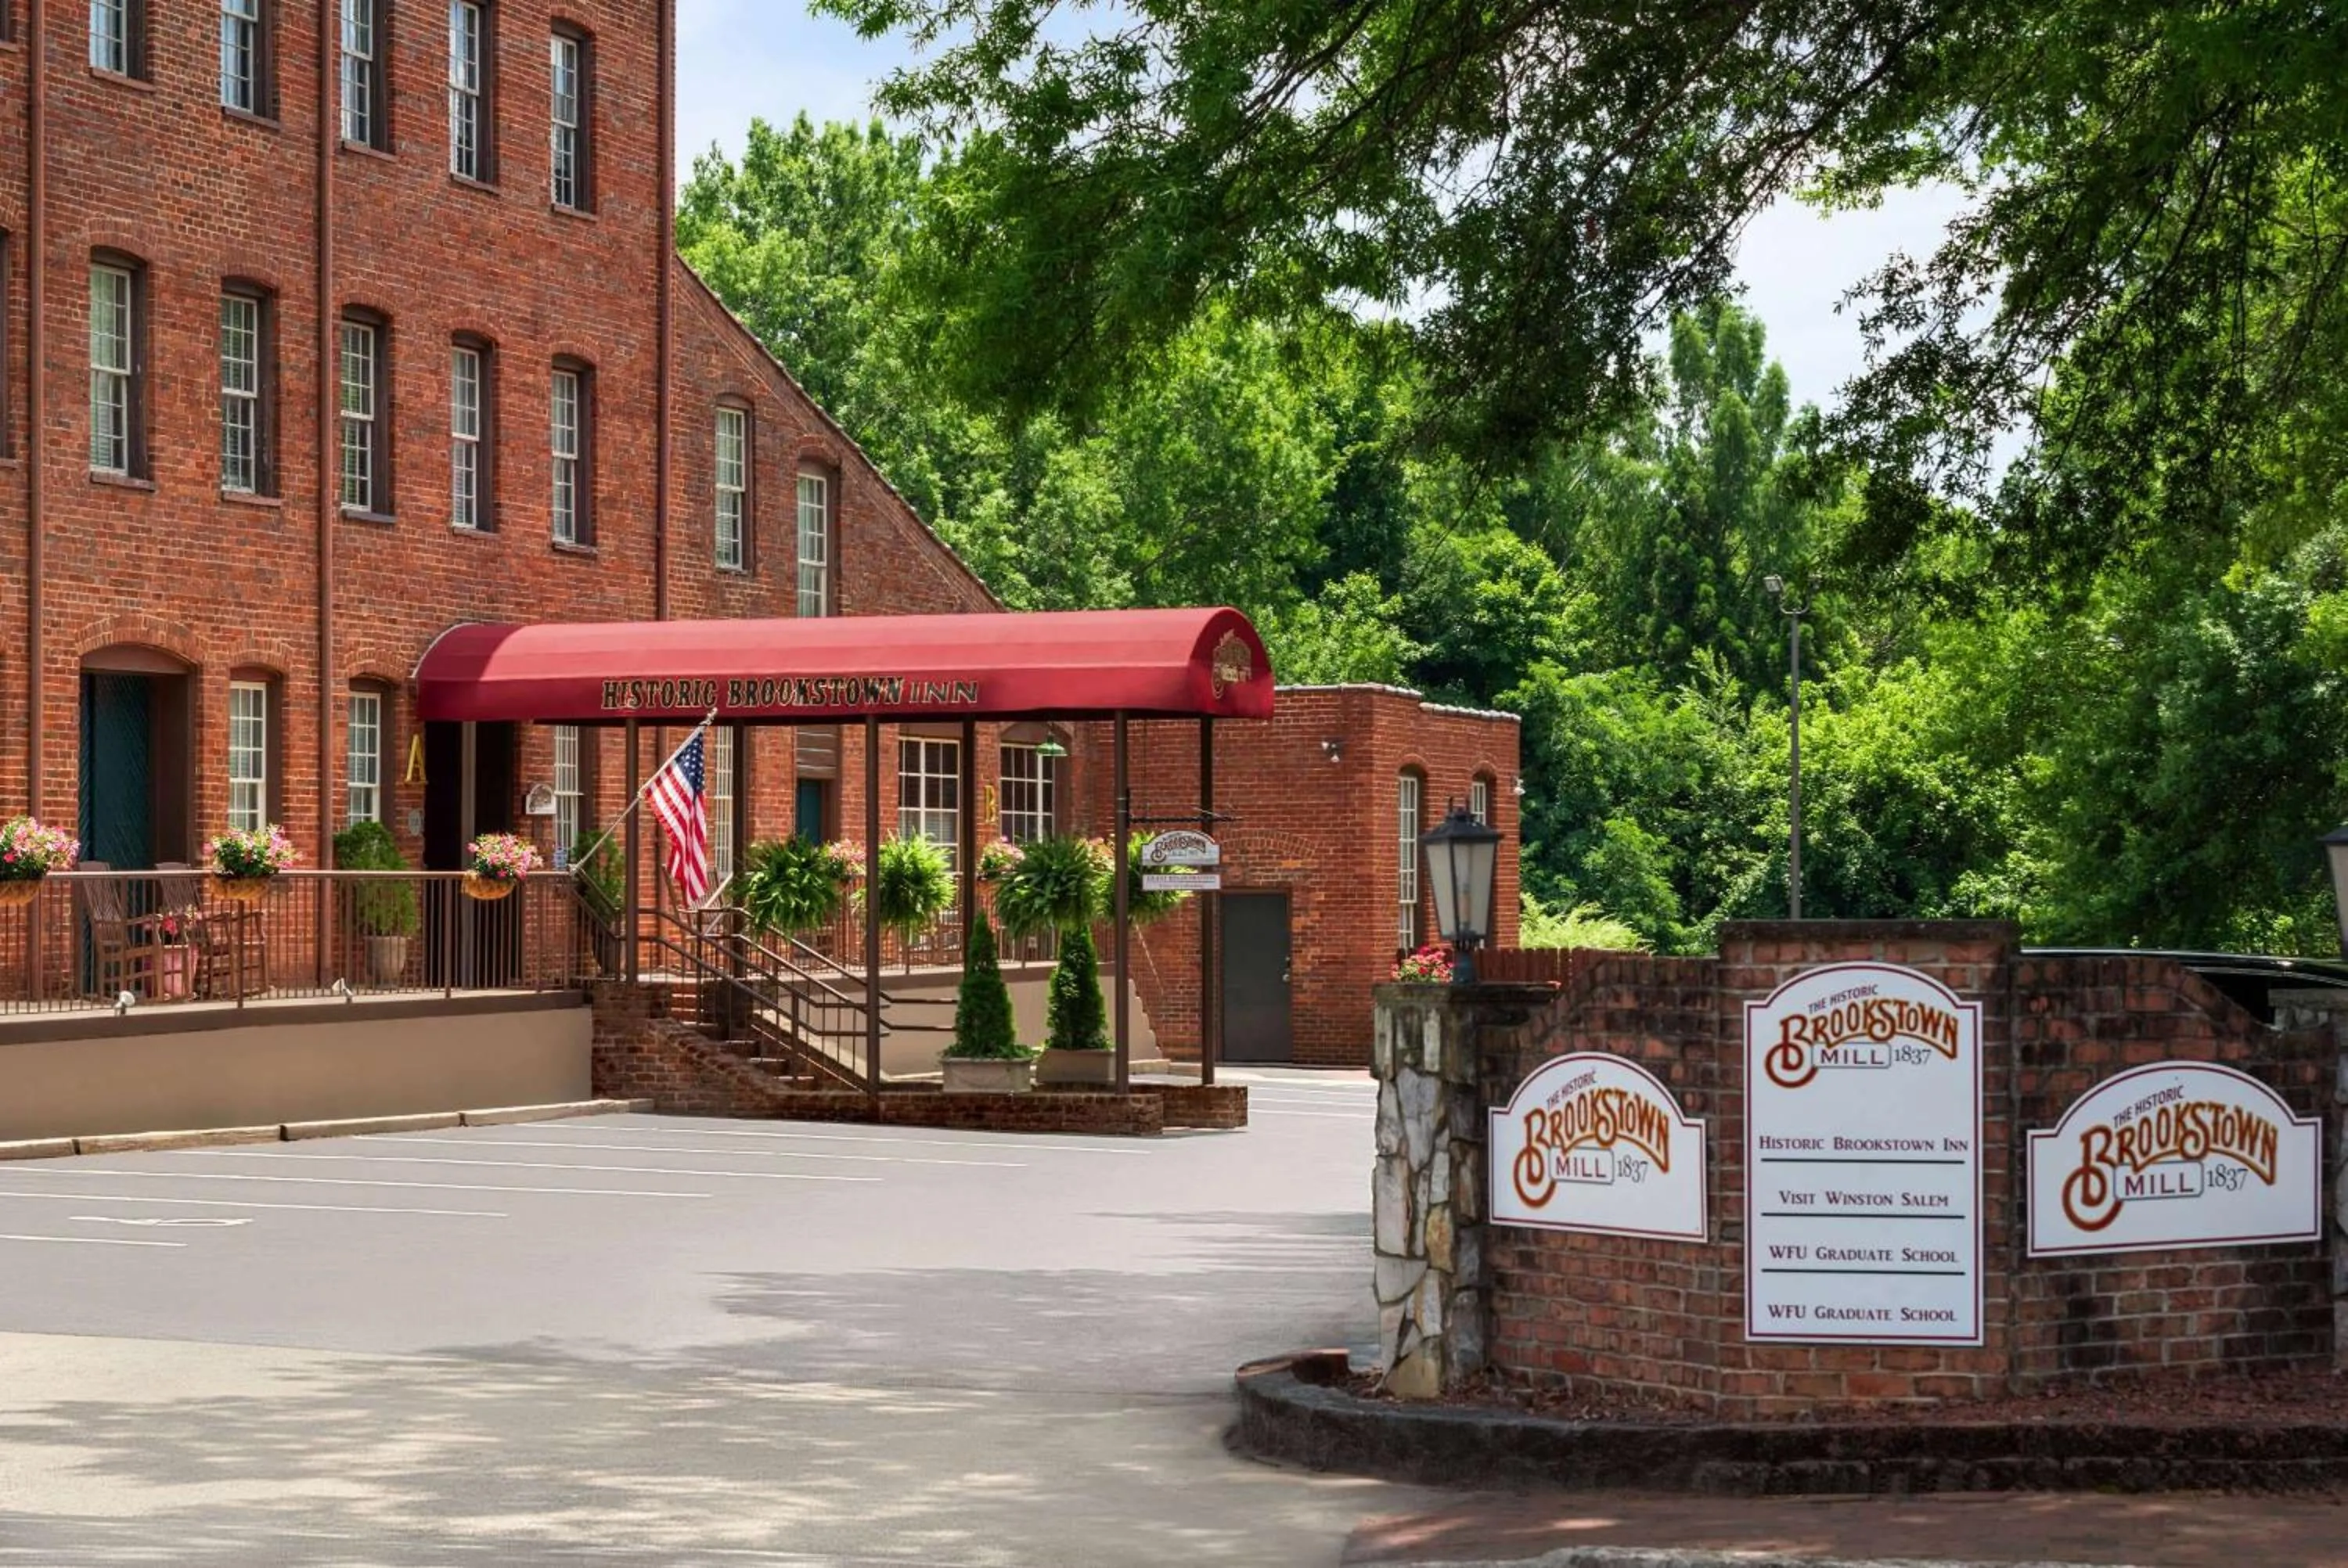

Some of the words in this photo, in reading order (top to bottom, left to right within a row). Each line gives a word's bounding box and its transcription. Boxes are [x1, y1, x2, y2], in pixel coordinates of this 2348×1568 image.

[601, 678, 718, 709] HISTORIC
[726, 676, 904, 707] BROOKSTOWN
[909, 680, 978, 703] INN
[405, 734, 427, 784] A
[1808, 998, 1827, 1014] THE
[1829, 984, 1878, 1005] HISTORIC
[1764, 998, 1959, 1088] BROOKSTOWN
[1820, 1049, 1885, 1065] MILL
[1894, 1045, 1932, 1065] 1837
[1547, 1091, 1560, 1110] THE
[1561, 1069, 1597, 1098] HISTORIC
[2113, 1106, 2133, 1129] THE
[2134, 1084, 2185, 1115] HISTORIC
[1513, 1087, 1669, 1210] BROOKSTOWN
[1556, 1156, 1607, 1178] MILL
[1617, 1154, 1648, 1183] 1837
[2061, 1100, 2278, 1232] BROOKSTOWN
[2124, 1172, 2195, 1196] MILL
[2207, 1163, 2249, 1191] 1837
[1769, 1245, 1807, 1260] WFU
[1767, 1304, 1806, 1319] WFU
